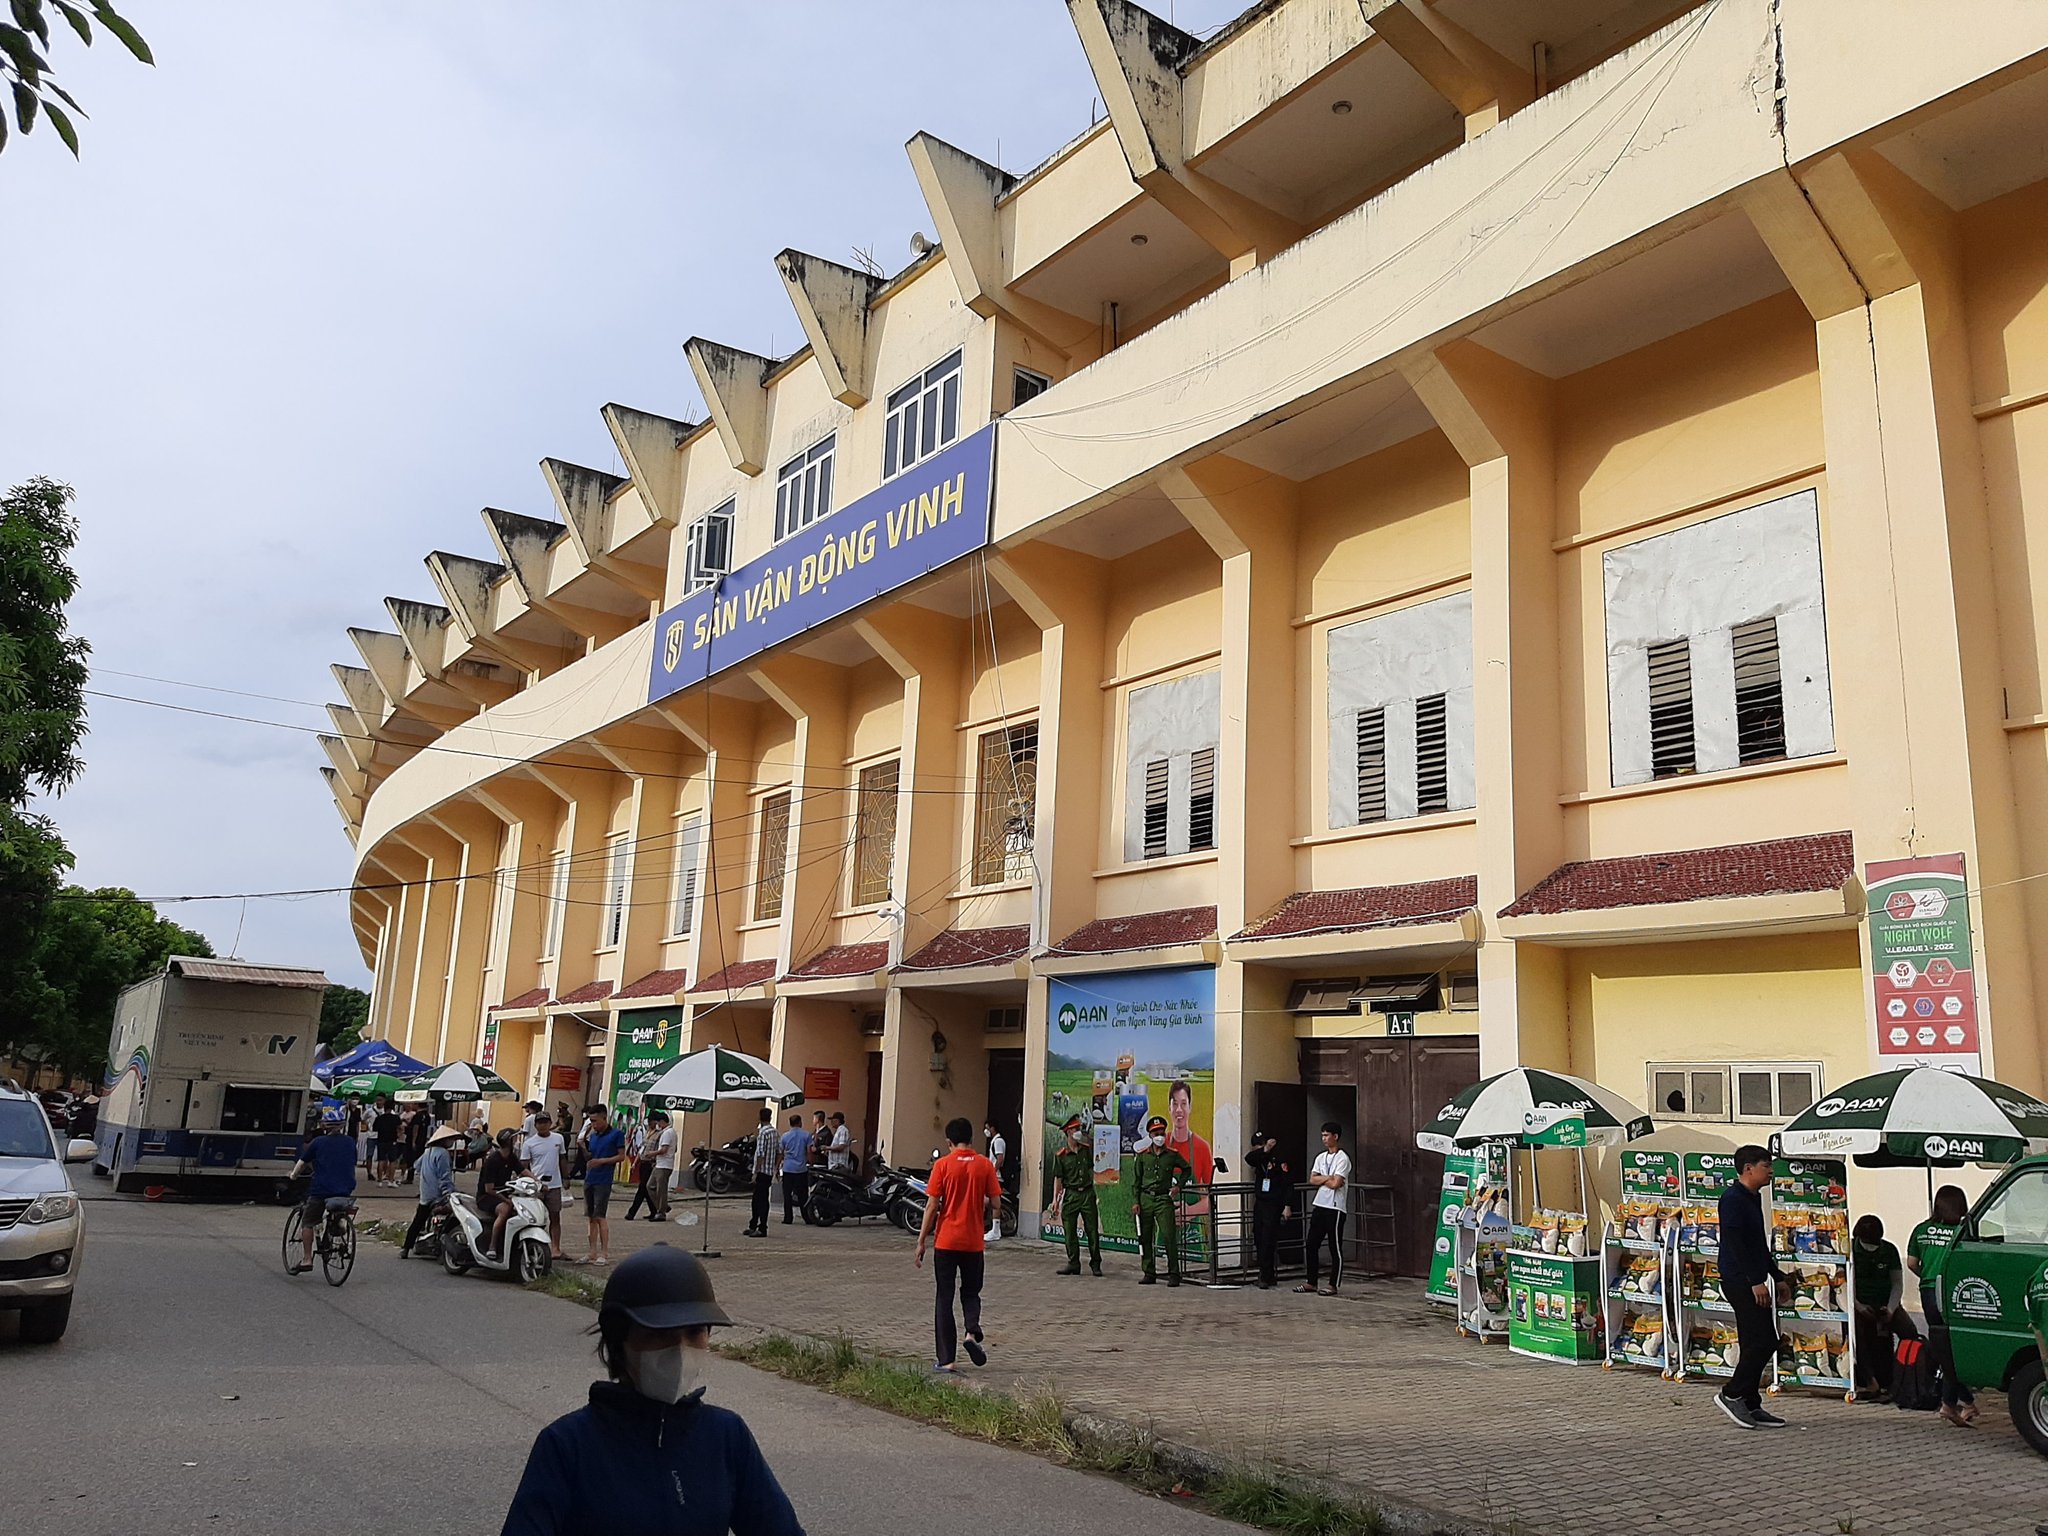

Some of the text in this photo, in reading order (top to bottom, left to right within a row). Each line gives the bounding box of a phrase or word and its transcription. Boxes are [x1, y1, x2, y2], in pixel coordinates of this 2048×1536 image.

[692, 596, 739, 650] SÂN
[744, 565, 793, 625] VẬN
[798, 520, 878, 594] ĐỘNG
[886, 472, 965, 549] VINH
[1884, 926, 1953, 944] NIGHT WOLF
[1885, 944, 1924, 954] V.LEAGUE
[1934, 943, 1955, 951] 2022
[1149, 1001, 1162, 1012] Cho
[1128, 1016, 1146, 1030] Ngon
[1169, 1013, 1182, 1028] Gia
